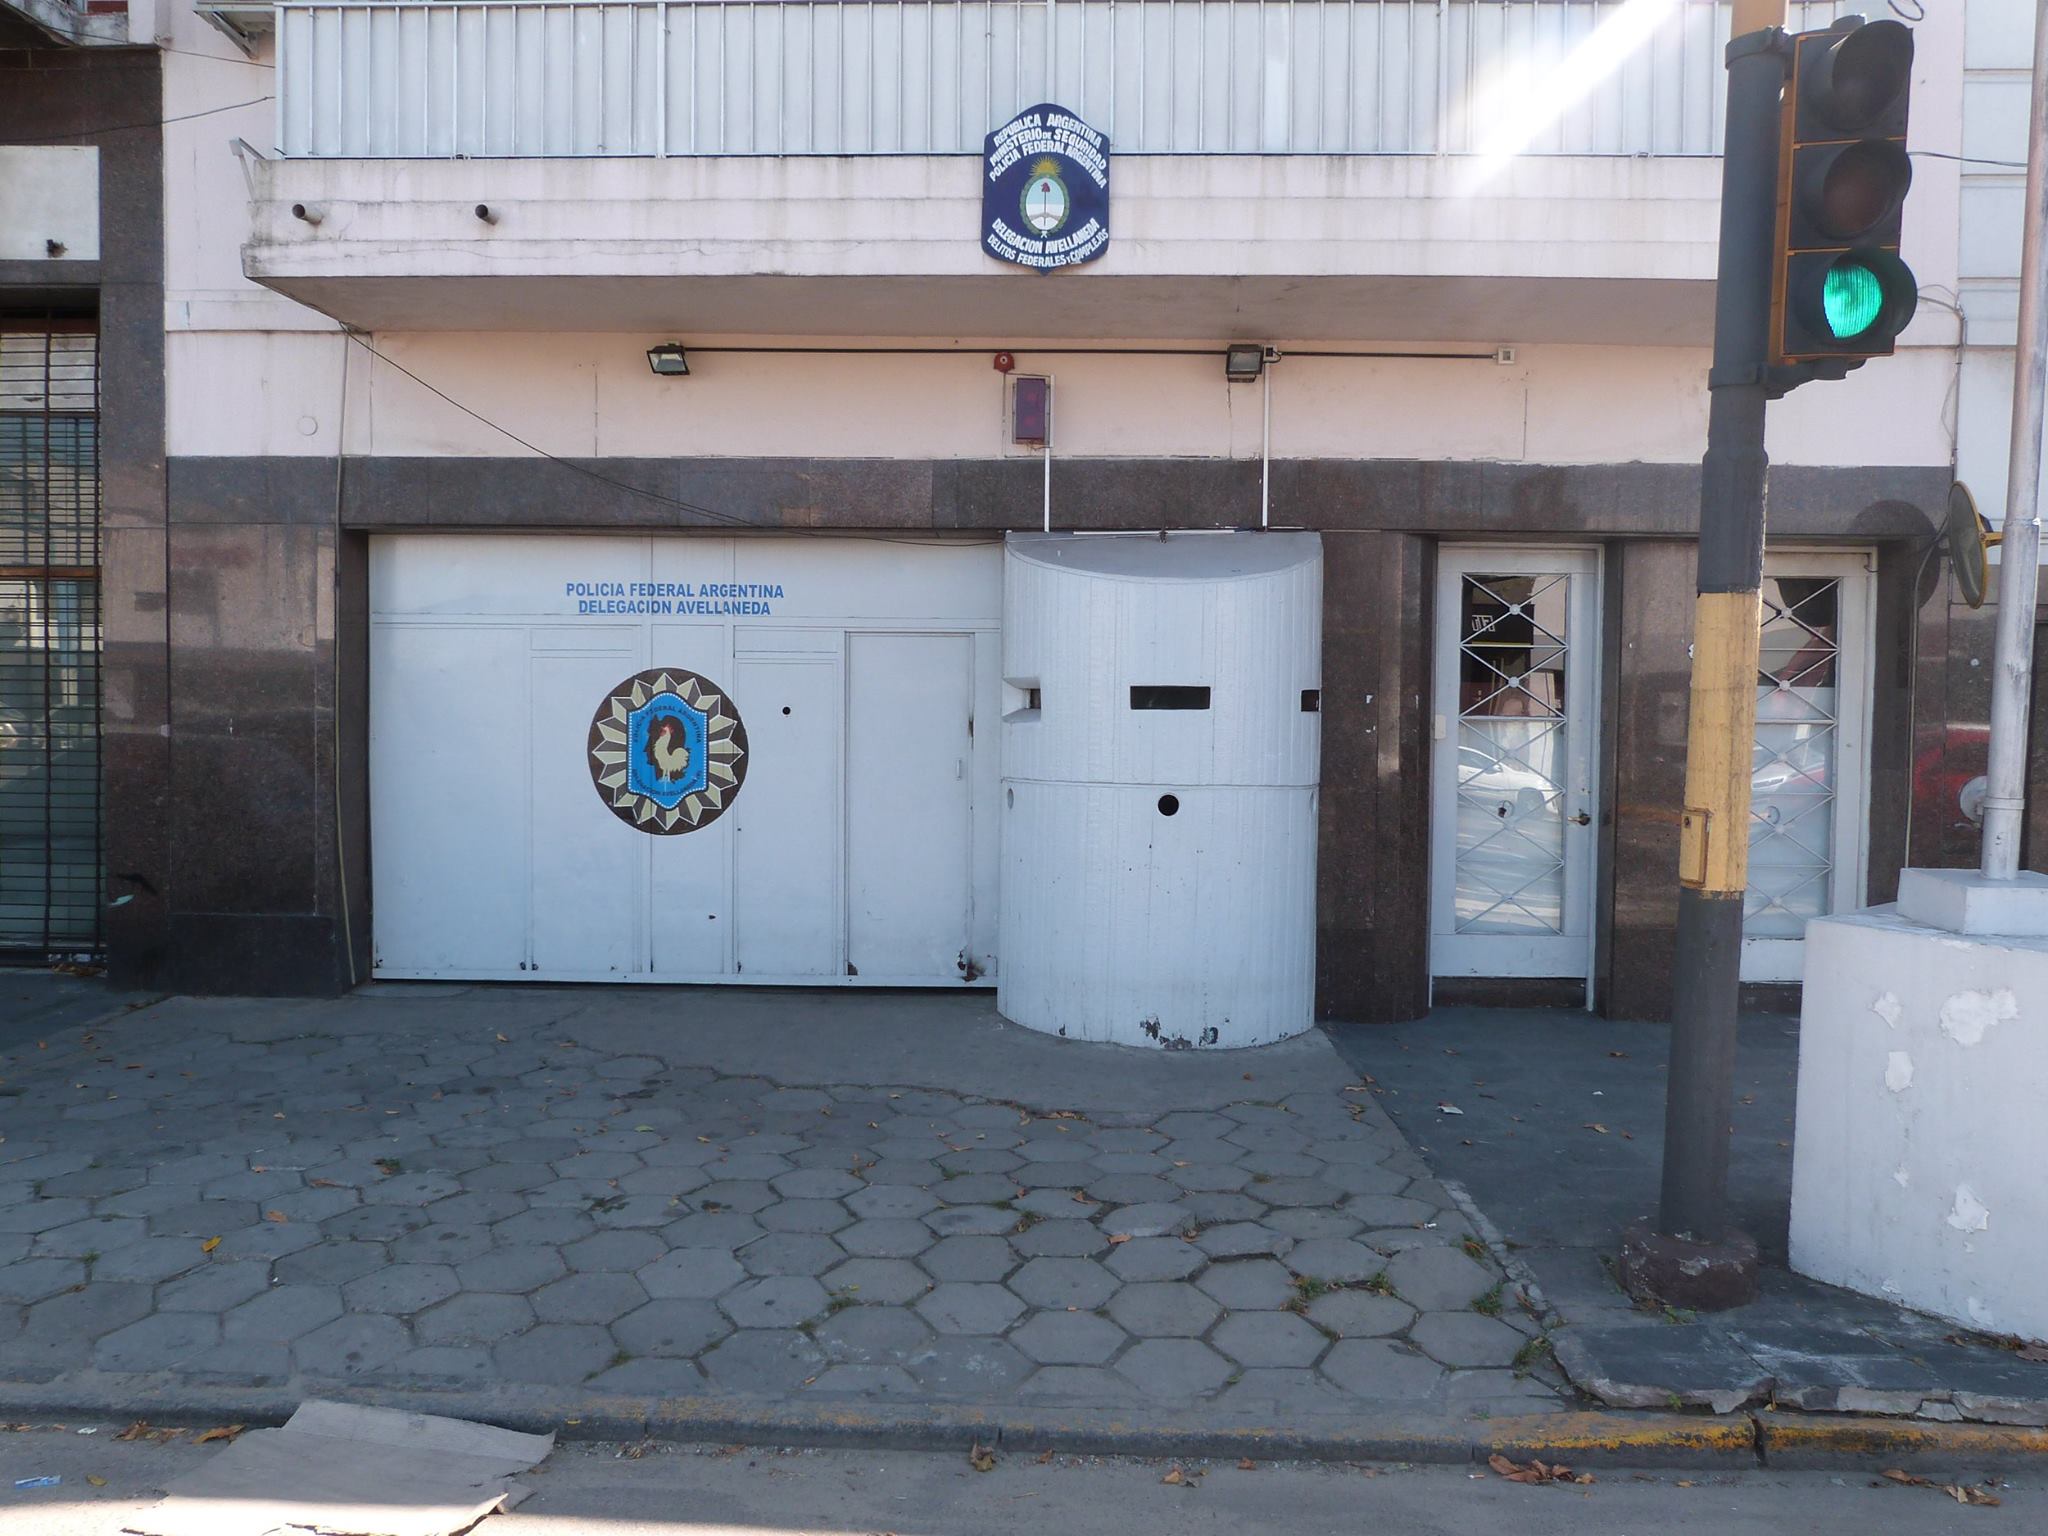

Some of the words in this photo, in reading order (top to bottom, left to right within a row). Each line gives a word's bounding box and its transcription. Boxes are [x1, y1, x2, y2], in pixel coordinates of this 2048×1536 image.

[990, 128, 1042, 167] MINISTERIO
[1042, 132, 1052, 140] DE
[1054, 128, 1107, 170] SEGURIDAD
[993, 114, 1041, 147] REPUBLICA
[1047, 113, 1102, 148] ARGENTINA
[989, 149, 1021, 182] POLICIA
[1021, 140, 1064, 156] FEDERAL
[1065, 147, 1107, 188] ARGENTINA
[987, 233, 1017, 260] DELITOS
[1016, 253, 1067, 268] FEDERALES
[1070, 228, 1109, 262] COMPLEJOS
[992, 217, 1042, 254] DELEGACION
[1045, 217, 1100, 254] AVELLANEDA
[566, 582, 625, 597] POLICIA
[630, 583, 695, 598] FEDERAL
[699, 583, 784, 598] ARGENTINA
[578, 600, 672, 614] DELEGACION
[676, 601, 771, 615] AVELLANEDA
